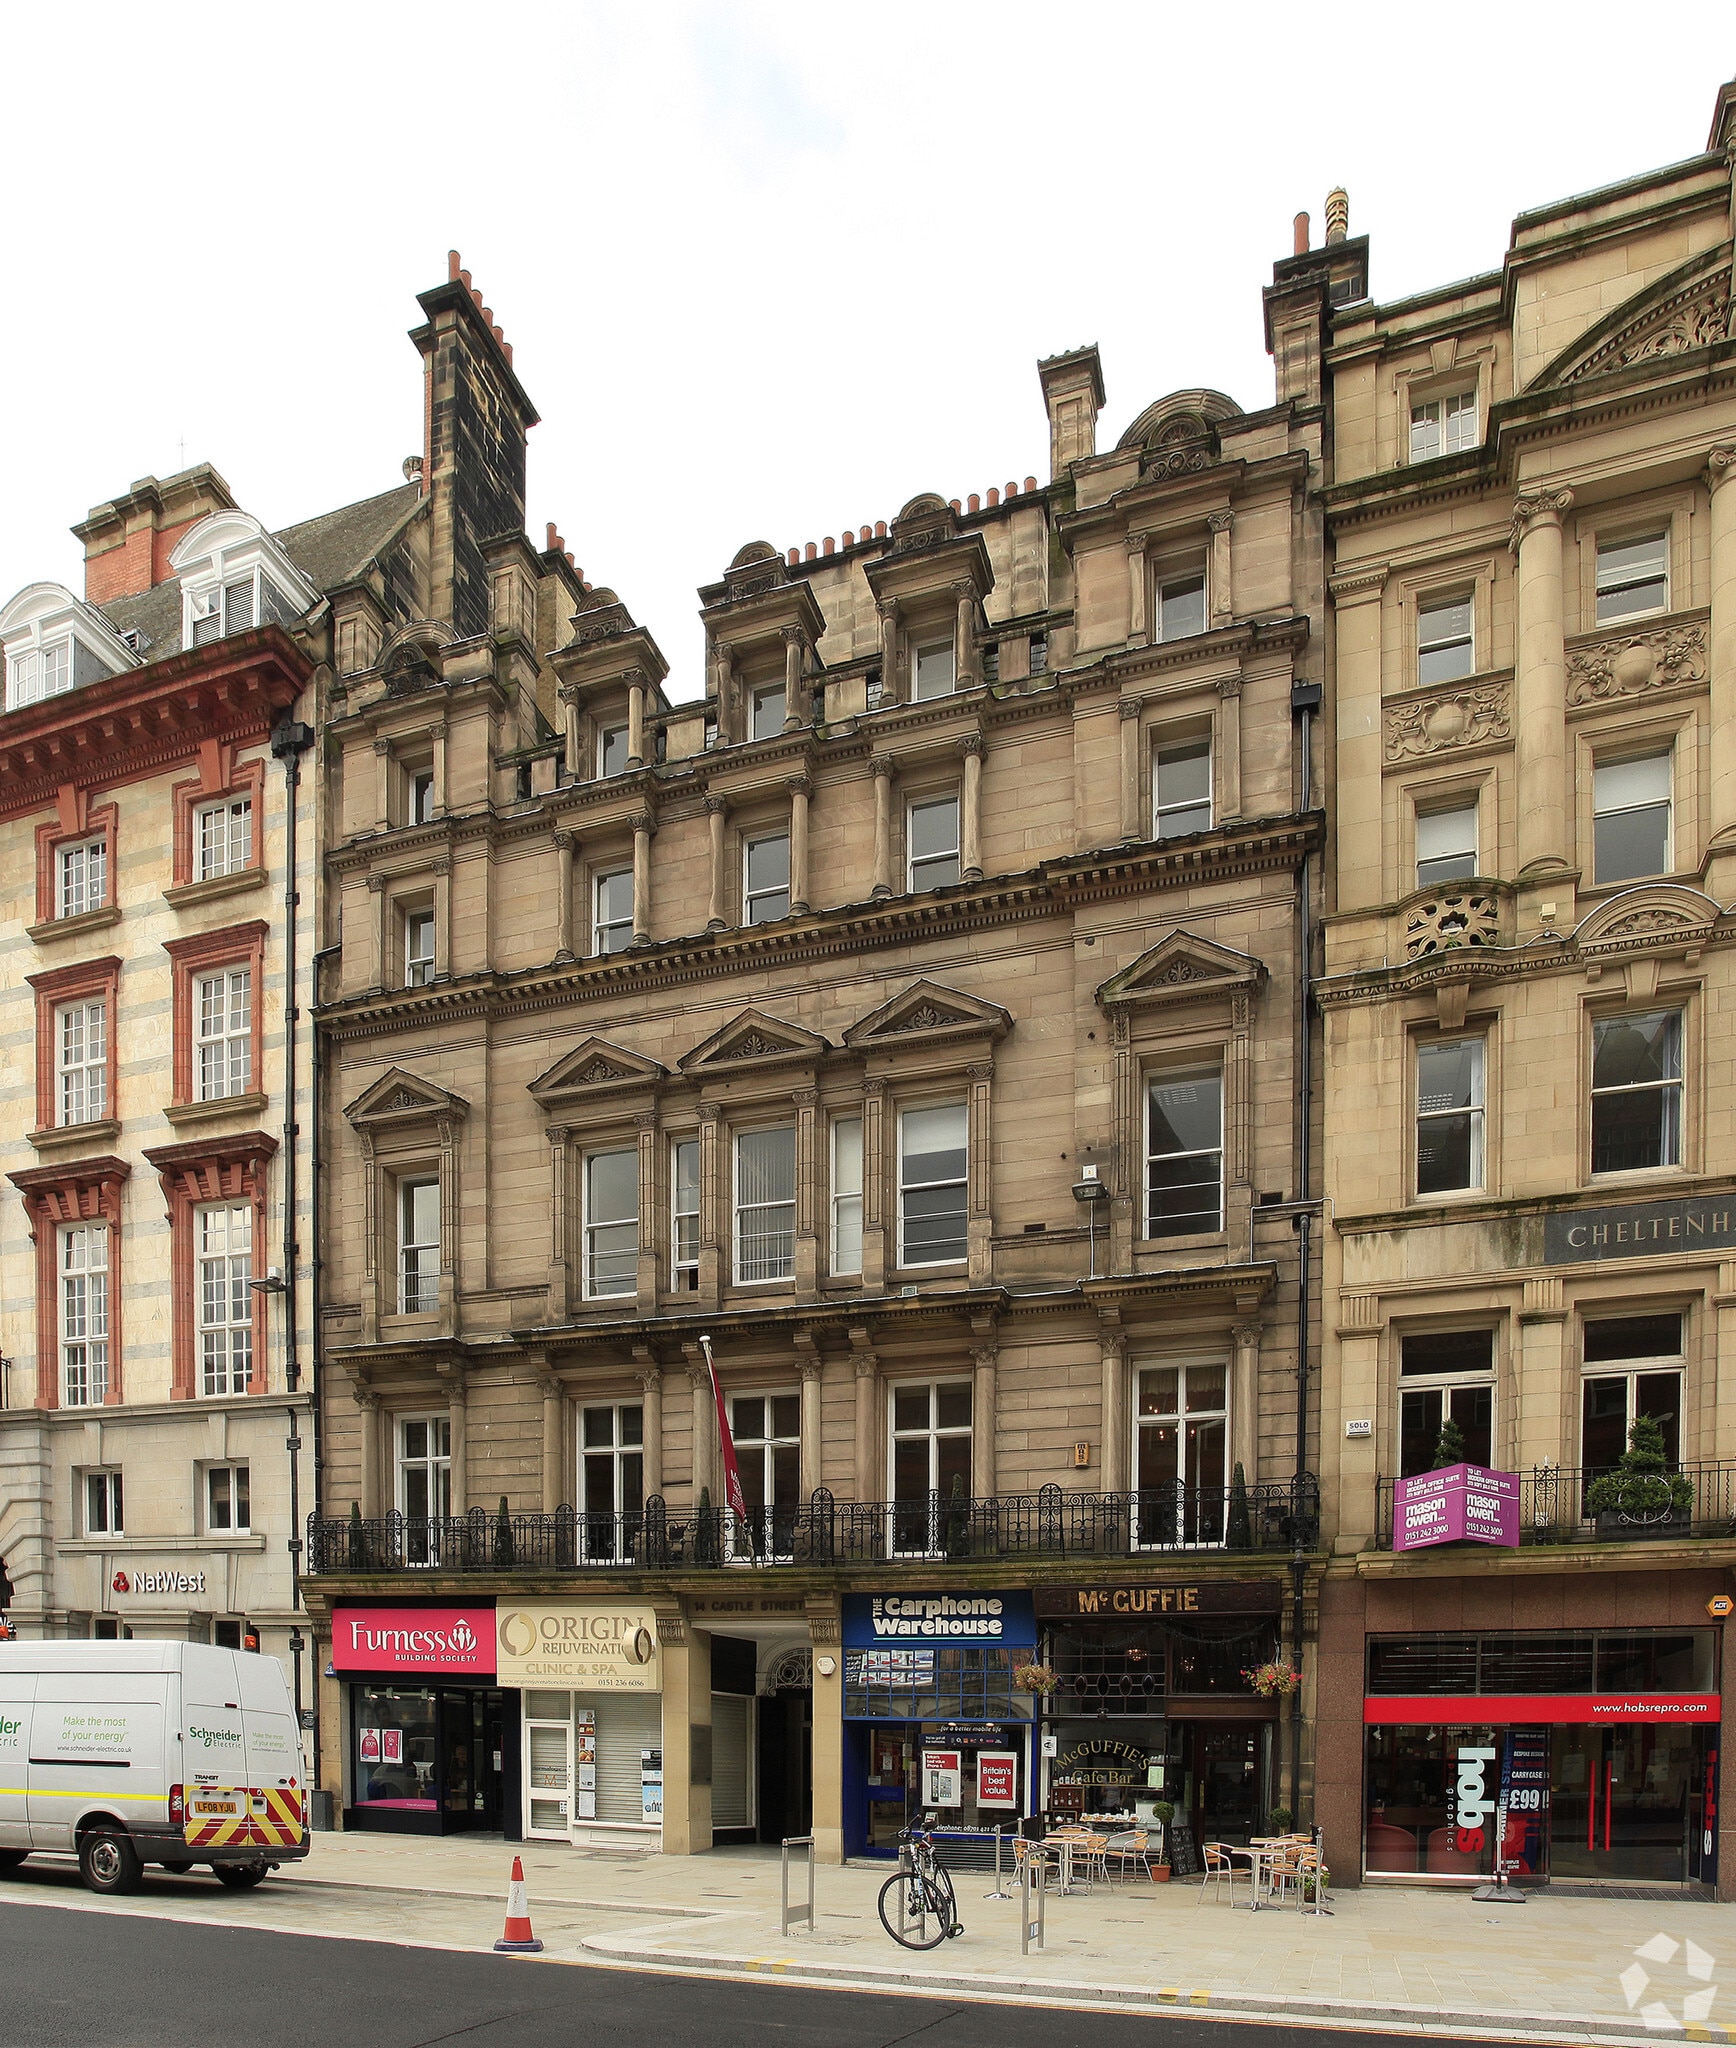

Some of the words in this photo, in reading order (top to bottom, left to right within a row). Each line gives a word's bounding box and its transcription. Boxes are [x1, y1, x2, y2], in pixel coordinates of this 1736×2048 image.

[1567, 1211, 1736, 1247] CHELTENH
[1405, 1497, 1446, 1517] mason
[1466, 1494, 1500, 1511] mason
[1405, 1531, 1419, 1540] 0151
[1420, 1528, 1432, 1538] 242
[1433, 1524, 1449, 1535] 3000
[1466, 1522, 1479, 1531] 0151
[1480, 1524, 1490, 1534] 242
[1490, 1526, 1503, 1536] 3000
[133, 1571, 206, 1593] NatWest
[694, 1602, 705, 1611] 14
[711, 1601, 754, 1612] CASTLE
[761, 1601, 805, 1611] STREET
[873, 1598, 882, 1617] THE
[885, 1596, 1003, 1619] Carphone
[873, 1617, 1003, 1635] Warehouse
[350, 1620, 447, 1652] Furness
[542, 1642, 625, 1656] REJUVENATI
[395, 1653, 437, 1662] BUILDING
[440, 1654, 477, 1662] SOCIETY
[526, 1663, 573, 1675] CLINIC
[577, 1664, 588, 1675] &
[591, 1664, 618, 1676] SPA
[598, 1679, 614, 1687] 0151
[628, 1680, 645, 1688] 6086
[1593, 1703, 1708, 1714] www.hobsrepro.com
[63, 1716, 86, 1726] Make
[87, 1716, 101, 1726] the
[104, 1718, 126, 1727] most
[62, 1730, 70, 1740] of
[72, 1731, 92, 1741] your
[189, 1726, 242, 1742] Schneider
[57, 1745, 132, 1753] www.schneider-electric.co.uk
[213, 1741, 242, 1749] Electric
[1055, 1740, 1151, 1770] McGUFFIE'S
[982, 1766, 1012, 1775] Britain's
[1072, 1770, 1106, 1784] Cafe
[1108, 1771, 1133, 1784] Bar
[1512, 1771, 1528, 1779] CARRY
[1529, 1771, 1543, 1779] CASE
[988, 1776, 1006, 1785] best
[984, 1787, 1008, 1795] value.
[1445, 1747, 1455, 1852] reprographics
[1456, 1747, 1497, 1853] hobs
[1509, 1789, 1540, 1810] £99
[1704, 1750, 1717, 1855] hobs
[198, 1803, 218, 1812] LF08
[219, 1804, 235, 1813] YJU
[935, 1824, 963, 1832] elephone:
